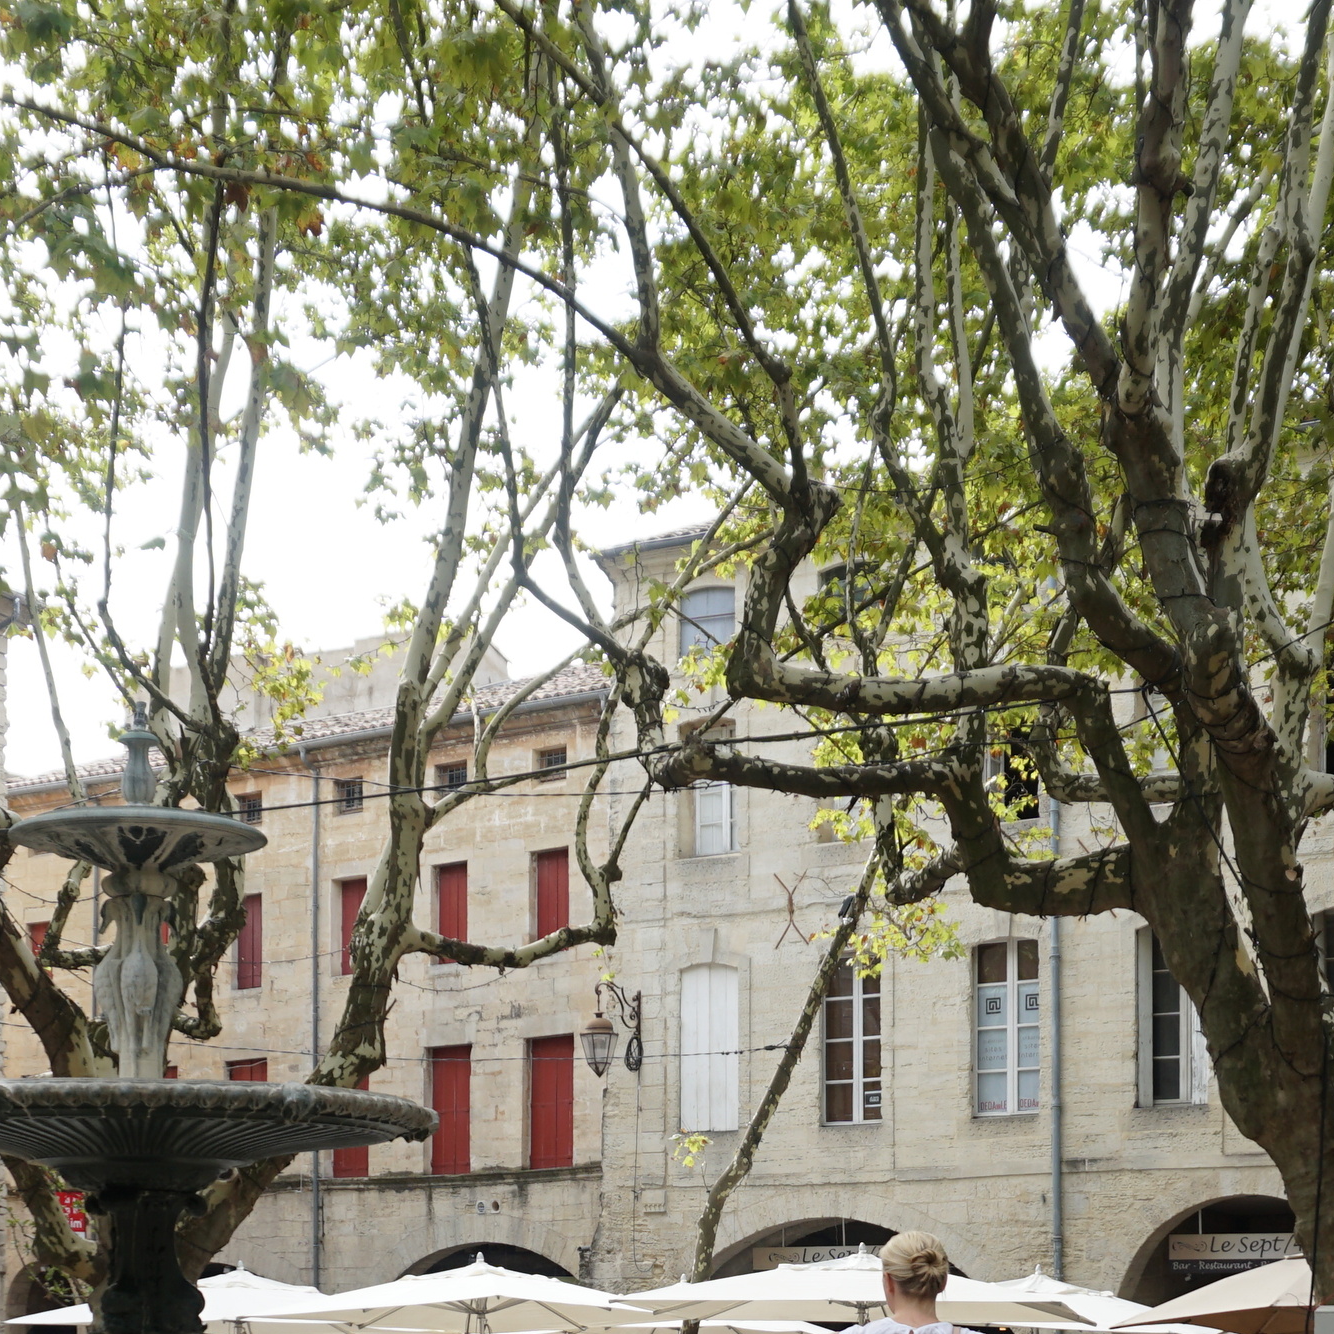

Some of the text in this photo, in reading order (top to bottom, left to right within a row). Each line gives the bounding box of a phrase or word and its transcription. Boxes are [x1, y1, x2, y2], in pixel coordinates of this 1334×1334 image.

[1210, 1236, 1235, 1252] Le
[802, 1247, 825, 1263] Le
[1172, 1261, 1192, 1270] Bar
[1198, 1261, 1252, 1270] Restaurant
